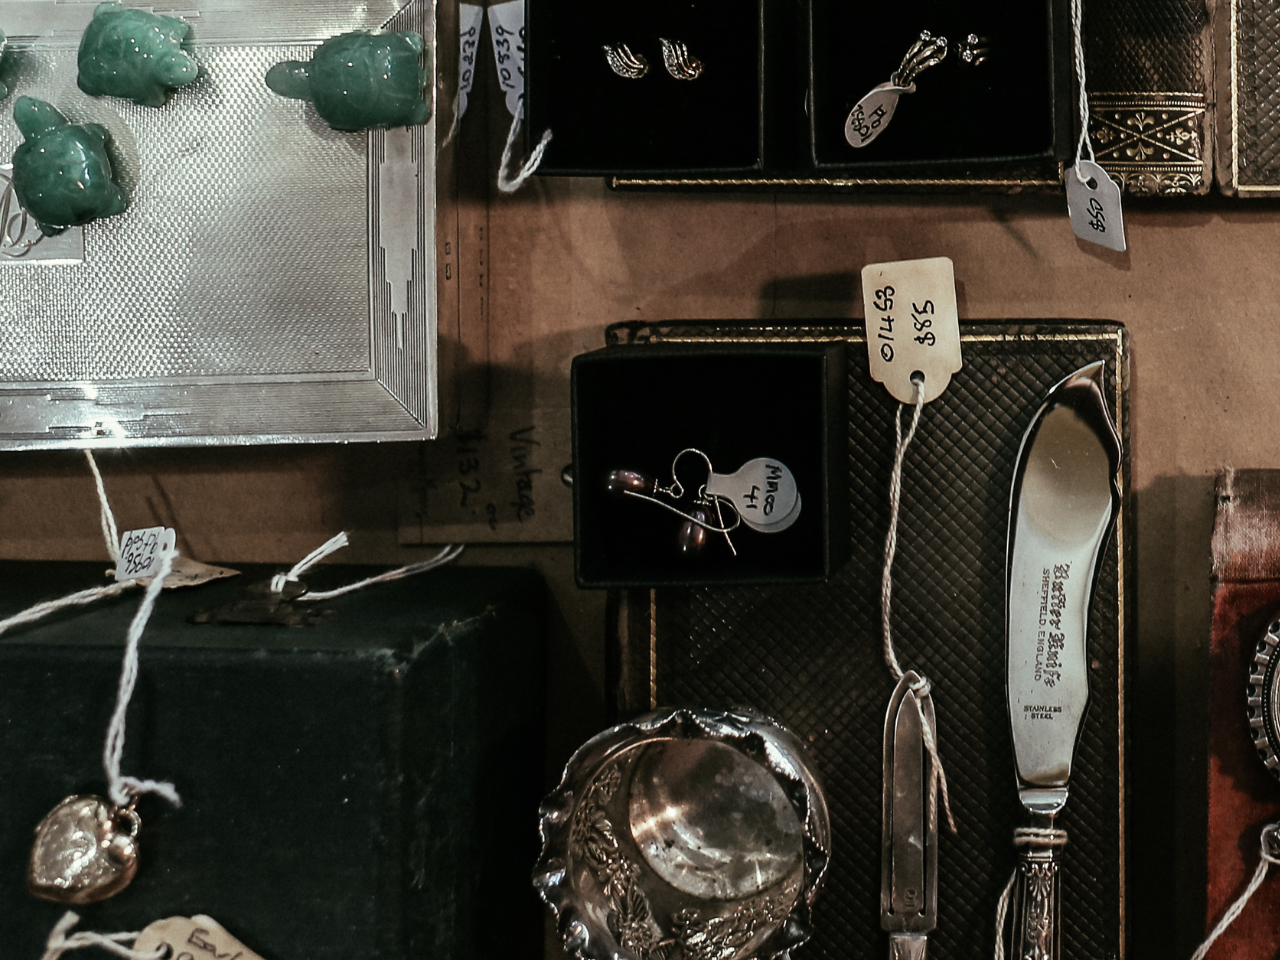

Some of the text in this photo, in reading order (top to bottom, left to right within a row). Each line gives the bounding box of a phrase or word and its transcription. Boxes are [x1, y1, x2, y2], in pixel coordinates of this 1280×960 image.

[872, 285, 896, 363] 01453
[910, 299, 936, 347] $85
[1033, 630, 1046, 682] ENGLAND
[1023, 705, 1062, 713] STAINLESS
[1030, 712, 1054, 720] STEEL
